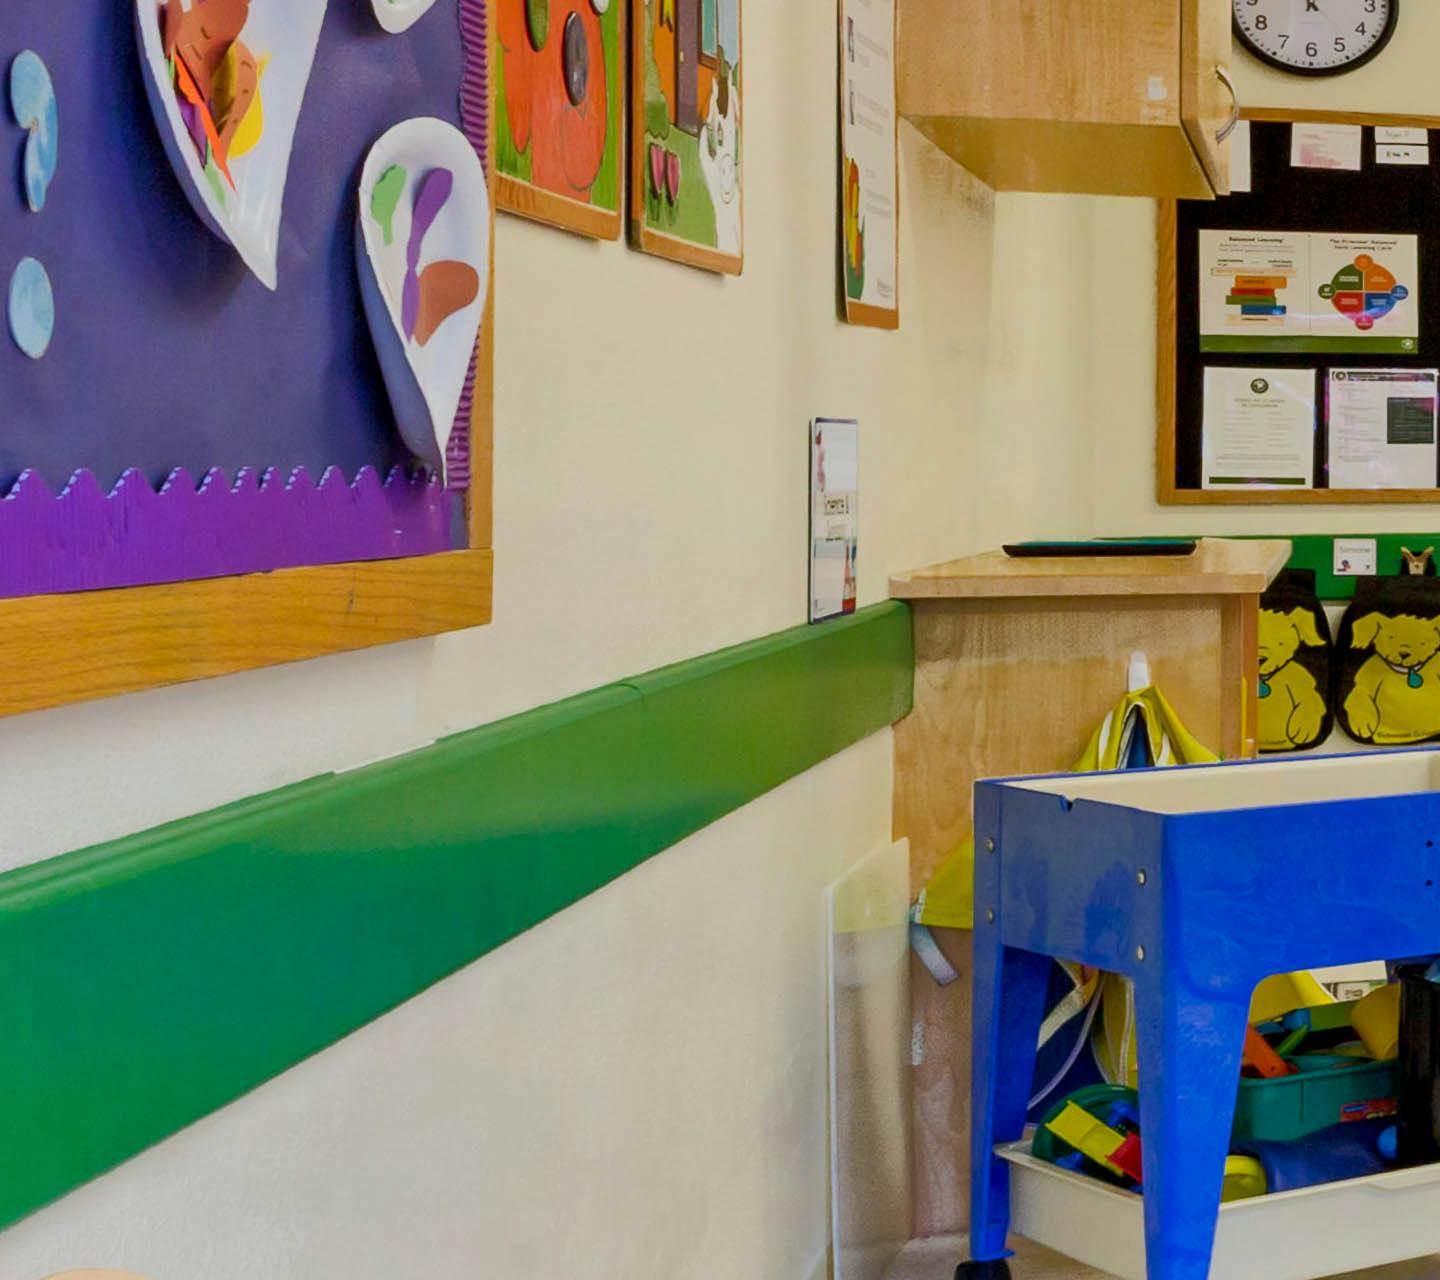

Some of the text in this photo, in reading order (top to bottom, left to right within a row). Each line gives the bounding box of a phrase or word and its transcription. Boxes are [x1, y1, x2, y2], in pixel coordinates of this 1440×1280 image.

[1255, 15, 1268, 30] 8
[1355, 22, 1367, 36] 4
[1278, 34, 1290, 49] 7
[1334, 37, 1346, 52] 5
[1305, 42, 1318, 57] 6
